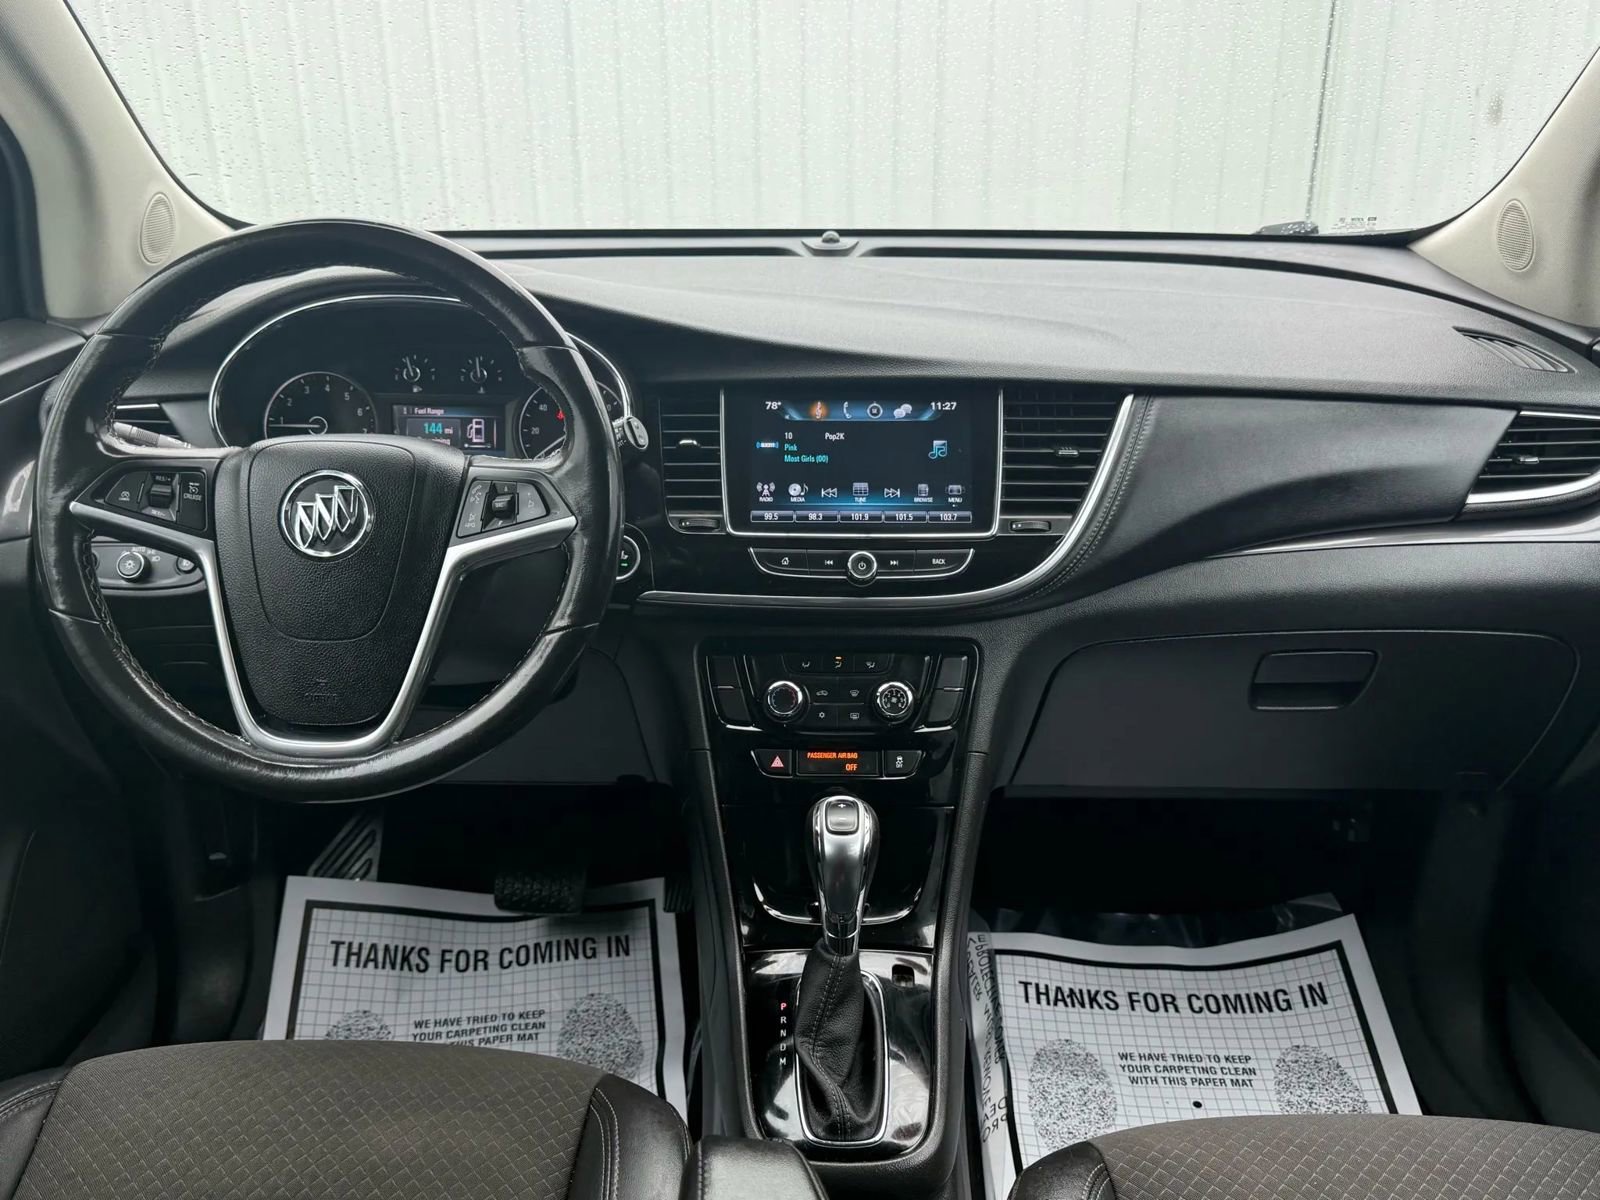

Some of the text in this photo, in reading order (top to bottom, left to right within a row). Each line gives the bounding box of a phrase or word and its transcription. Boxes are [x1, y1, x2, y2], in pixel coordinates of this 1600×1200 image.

[344, 392, 350, 400] 5
[930, 401, 957, 410] 11:27
[427, 407, 444, 416] Range
[424, 422, 442, 434] 144
[531, 426, 540, 434] 20
[825, 432, 845, 441] Pop2K
[784, 443, 798, 451] Pink
[784, 455, 800, 463] Most
[801, 455, 815, 463] Girls
[764, 512, 779, 520] 99.5
[808, 512, 823, 520] 98.3
[851, 512, 869, 520] 101.9
[807, 752, 836, 760] PASSENGER
[845, 763, 858, 771] OFF
[330, 934, 631, 973] THANKS FOR COMING IN
[1018, 981, 1328, 1015] THANKS FOR COMING IN
[780, 1002, 787, 1010] P
[414, 1009, 545, 1029] WE HAVE TRIED TO KEEP
[780, 1016, 787, 1024] R
[412, 1021, 546, 1042] YOUR CARPETING CLEAN
[780, 1029, 787, 1037] N
[478, 1033, 513, 1046] PAPER
[517, 1032, 540, 1041] MAT
[780, 1043, 787, 1051] D
[780, 1057, 787, 1065] M
[1118, 1052, 1252, 1064] WE HAVE TRIED TO KEEP
[1119, 1064, 1257, 1077] YOUR CARPETING CLEAN
[1128, 1076, 1254, 1088] WITH THIS PAPER MAT
